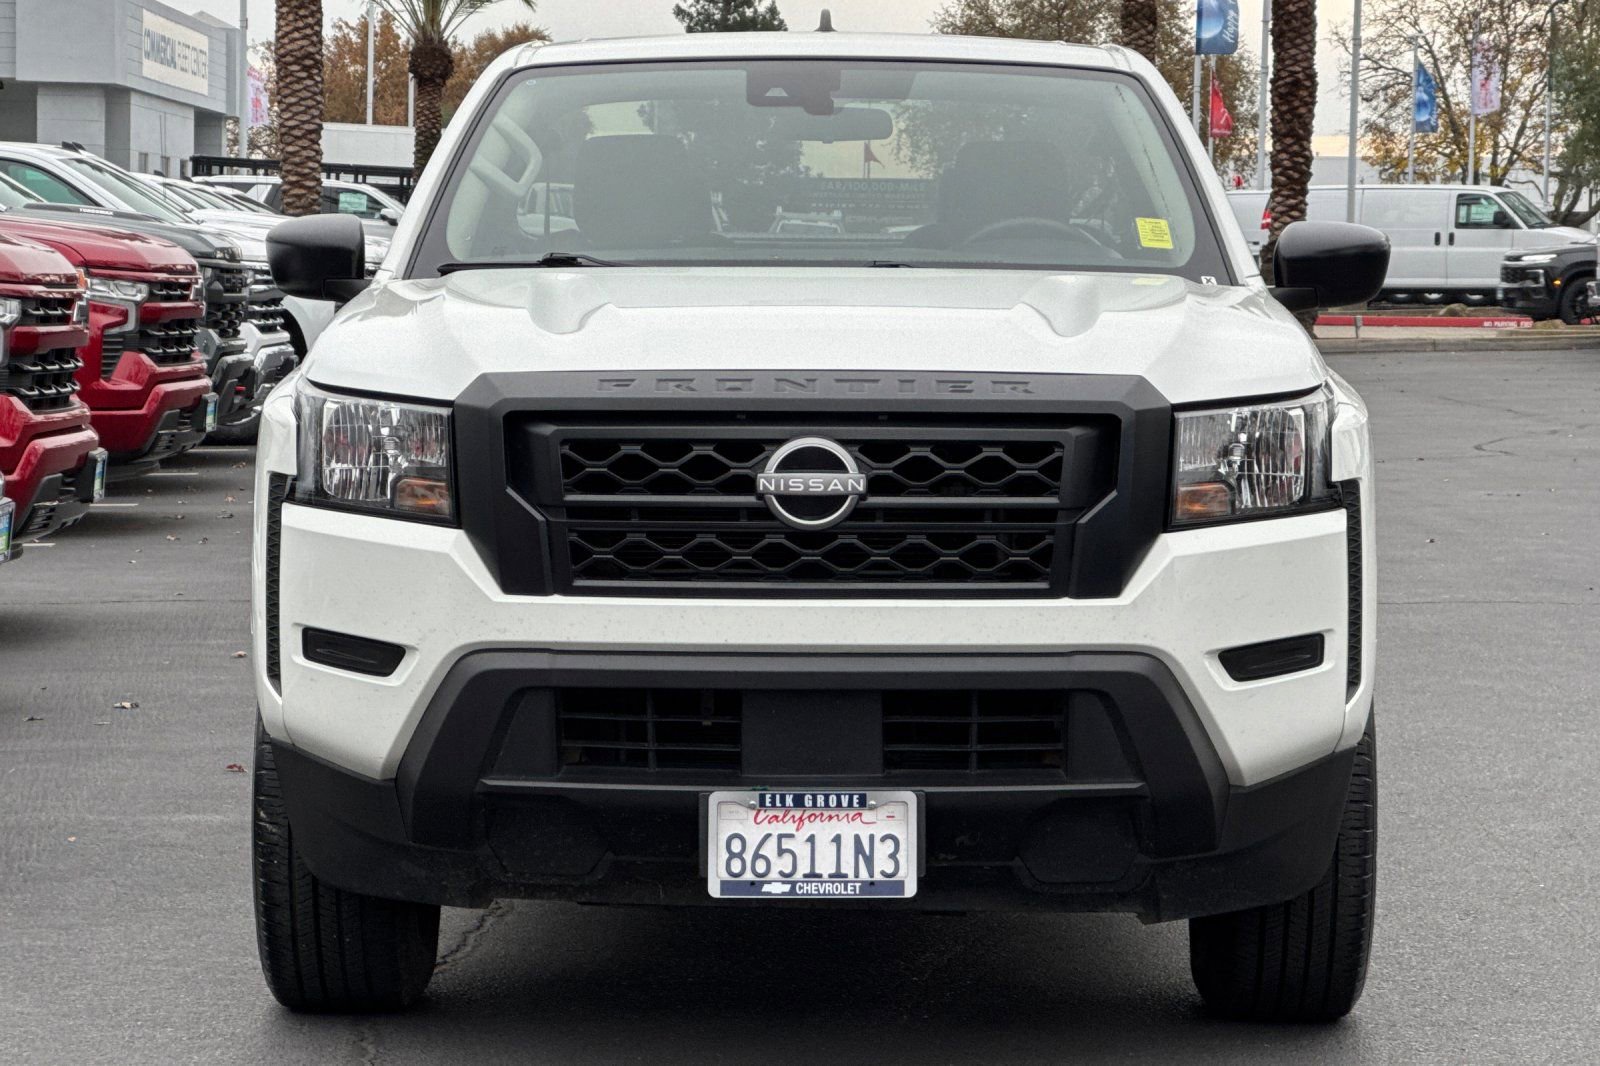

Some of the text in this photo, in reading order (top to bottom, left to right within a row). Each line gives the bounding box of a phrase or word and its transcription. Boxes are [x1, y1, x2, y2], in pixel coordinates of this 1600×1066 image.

[598, 377, 1035, 394] FRONTIER
[759, 478, 864, 492] NISSAN
[765, 794, 860, 808] ELK GROVE
[753, 809, 877, 832] California
[725, 832, 901, 879] 86511N3
[795, 882, 862, 895] CHEVROLET
